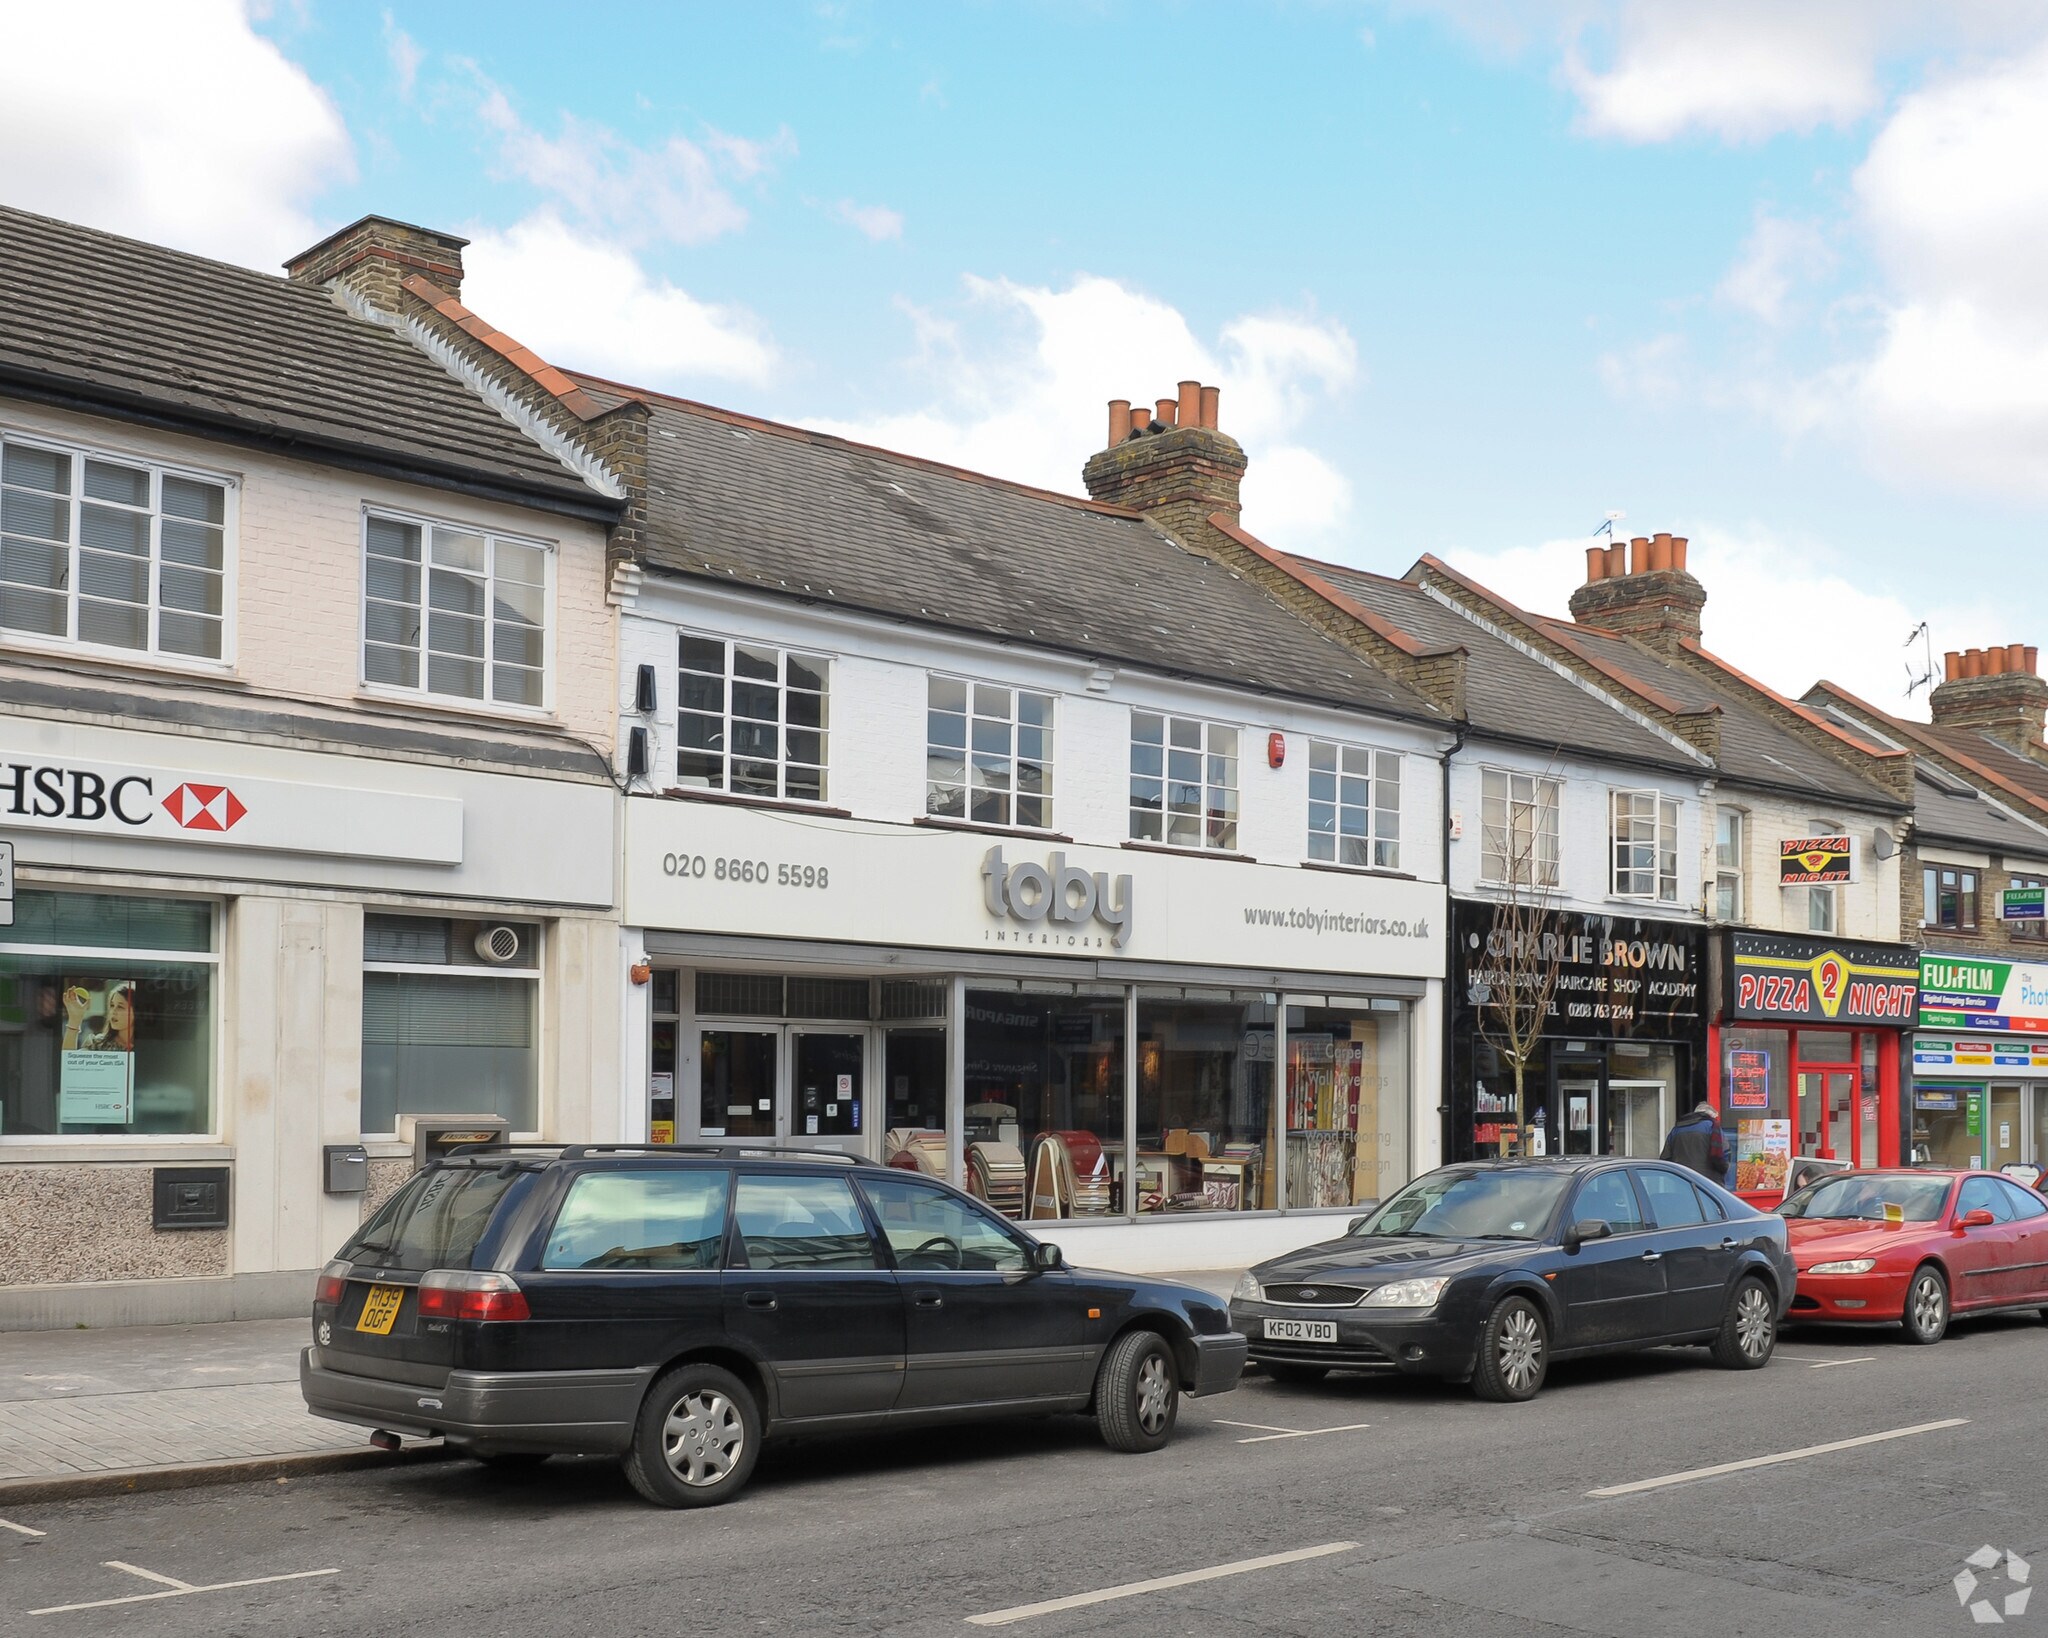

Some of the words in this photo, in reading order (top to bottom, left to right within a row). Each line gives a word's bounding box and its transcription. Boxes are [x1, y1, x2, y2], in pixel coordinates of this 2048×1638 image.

[0, 763, 153, 825] HSBC
[1782, 837, 1849, 855] PIZZA
[1806, 854, 1823, 866] 2
[663, 852, 706, 879] 020
[714, 857, 769, 884] 8660
[778, 863, 829, 889] 5598
[1782, 871, 1849, 883] NIGHT
[981, 844, 1133, 949] toby
[1244, 906, 1429, 938] www.tobyinteriors.co.uk
[985, 930, 1103, 947] INTERIORS
[1486, 929, 1593, 964] CHARLIE
[1600, 938, 1685, 972] BROWN
[1468, 968, 1549, 988] HAIRDRSSING
[1555, 975, 1608, 991] HAIRCARE
[1614, 978, 1641, 994] SHOP
[1648, 981, 1697, 997] ACADEMY
[1739, 973, 1809, 1013] PIZZA
[1820, 959, 1840, 1001] 2
[1848, 982, 1917, 1018] NIGHT
[1923, 994, 1943, 1004] Digital
[1568, 1002, 1592, 1018] 0208
[1593, 1003, 1610, 1019] 763
[1351, 1156, 1391, 1174] Desgn
[1269, 1321, 1302, 1337] KF02
[1305, 1323, 1331, 1339] VBO
